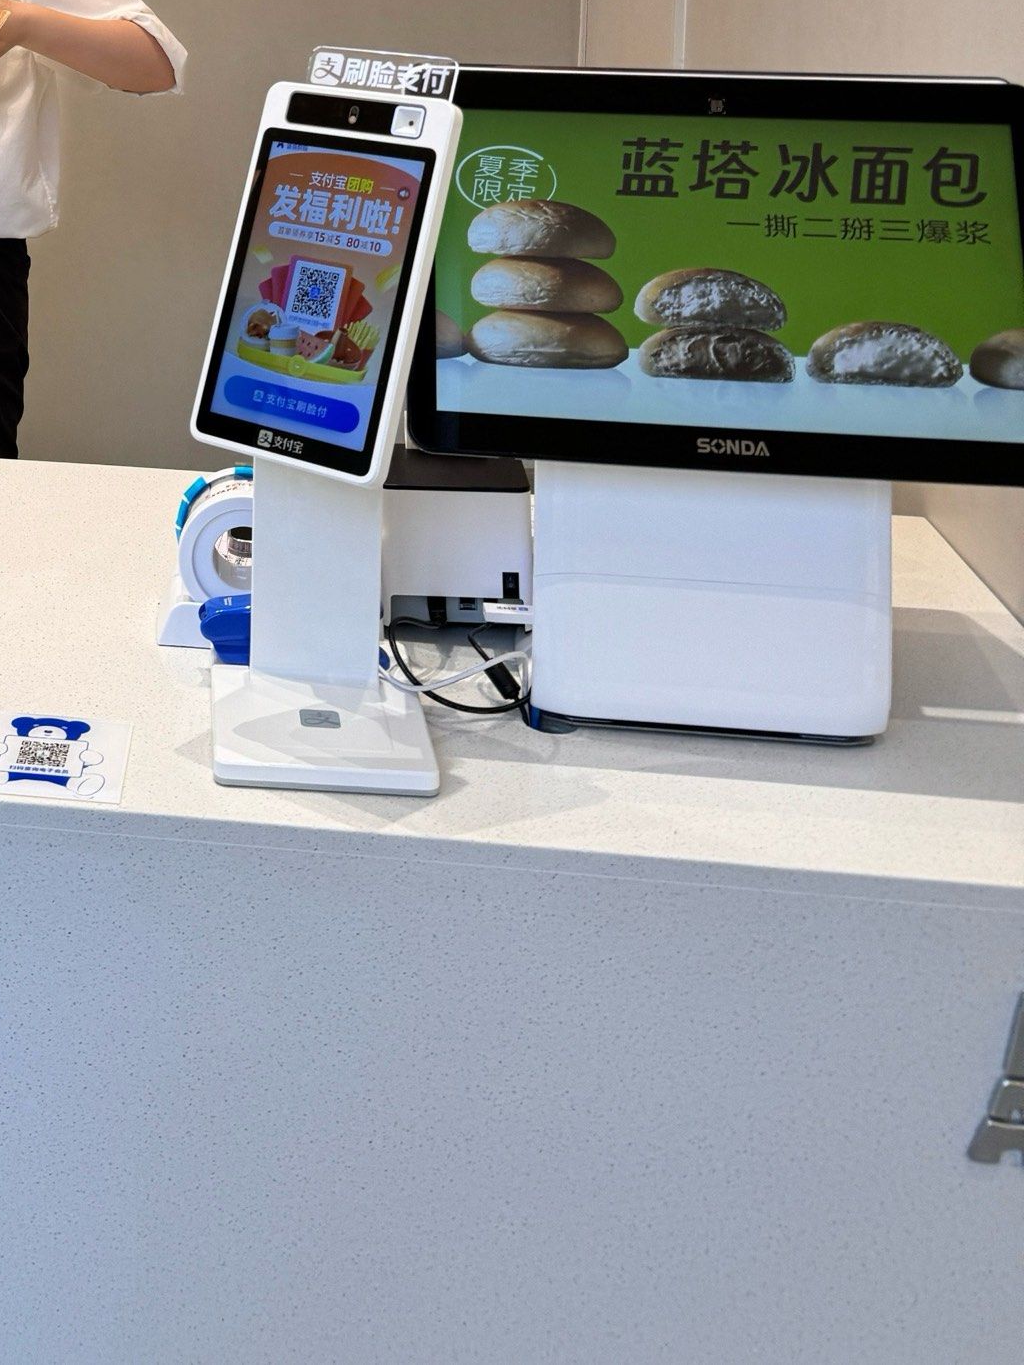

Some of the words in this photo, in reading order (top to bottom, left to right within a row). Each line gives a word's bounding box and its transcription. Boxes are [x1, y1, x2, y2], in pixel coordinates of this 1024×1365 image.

[342, 57, 450, 95] 刷脸支付
[309, 171, 374, 194] 支付宝团购
[474, 154, 539, 181] 夏季
[615, 136, 988, 208] 蓝塔冰面包
[726, 213, 992, 246] 一撕二掰三爆浆
[696, 437, 770, 458] SONDA
